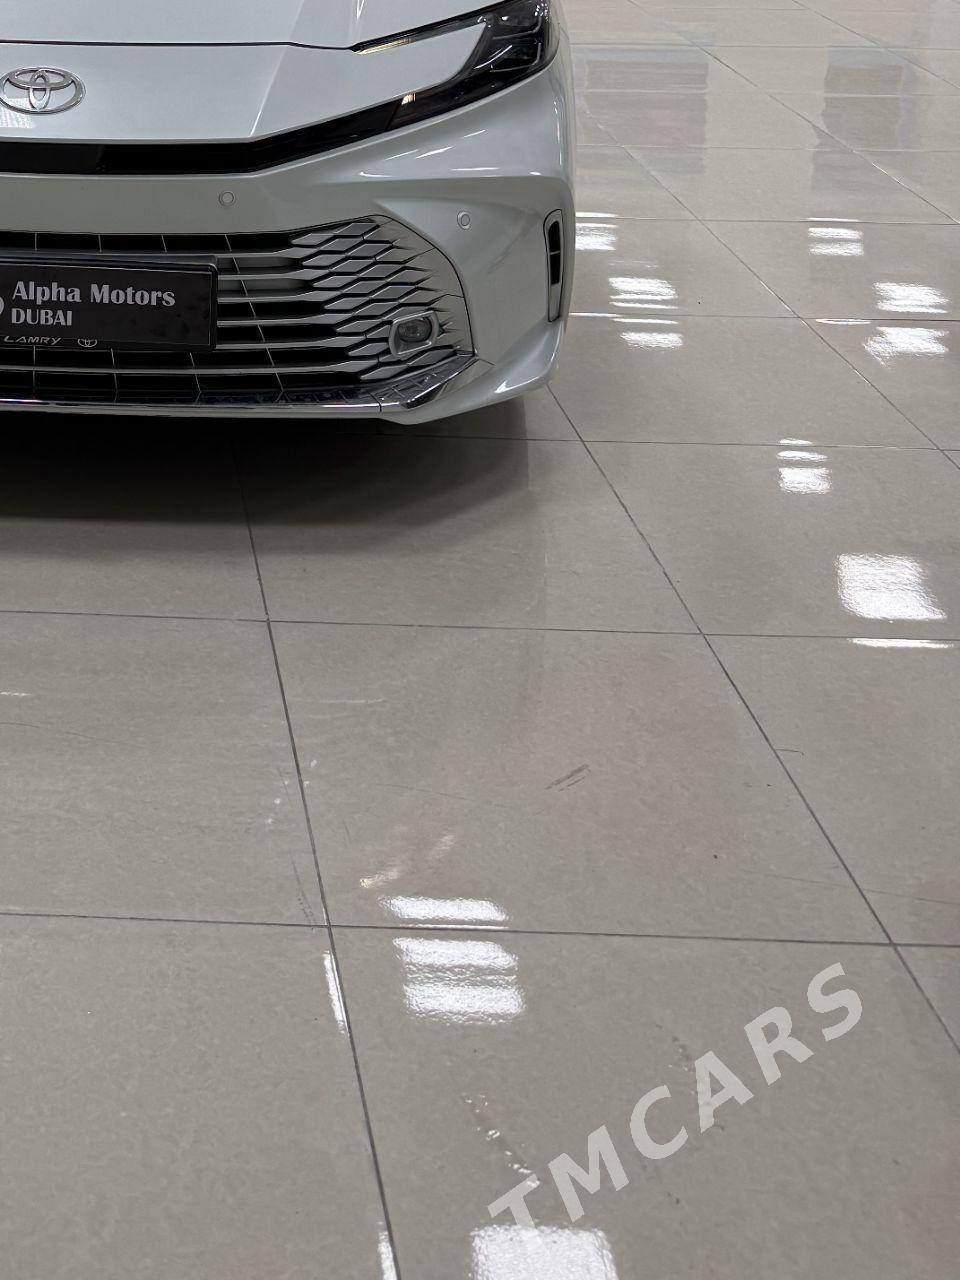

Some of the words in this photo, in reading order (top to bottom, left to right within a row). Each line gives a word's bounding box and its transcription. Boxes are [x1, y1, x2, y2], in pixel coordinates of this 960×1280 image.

[12, 281, 82, 305] Alpha
[90, 283, 176, 307] Motors
[11, 308, 73, 326] DUBAI
